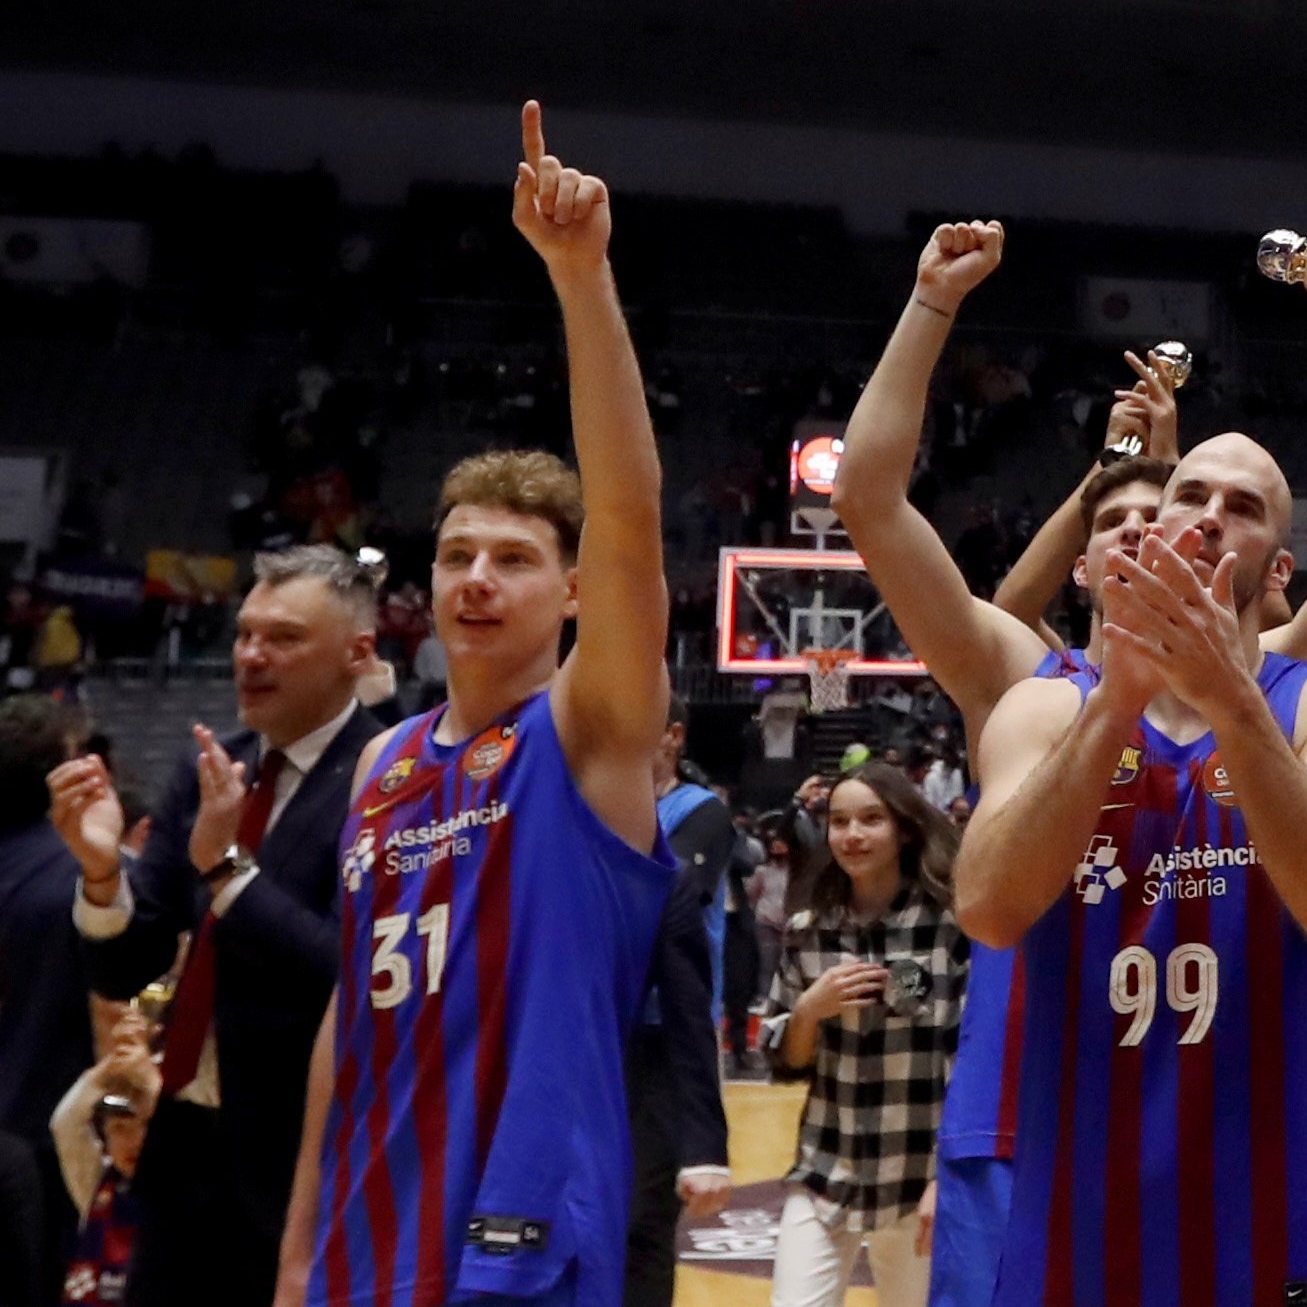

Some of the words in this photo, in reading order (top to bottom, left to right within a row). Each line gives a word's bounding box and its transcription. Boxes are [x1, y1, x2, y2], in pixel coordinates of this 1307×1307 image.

[1142, 871, 1228, 906] Snitària
[370, 902, 450, 1010] 31
[1108, 942, 1219, 1047] 99
